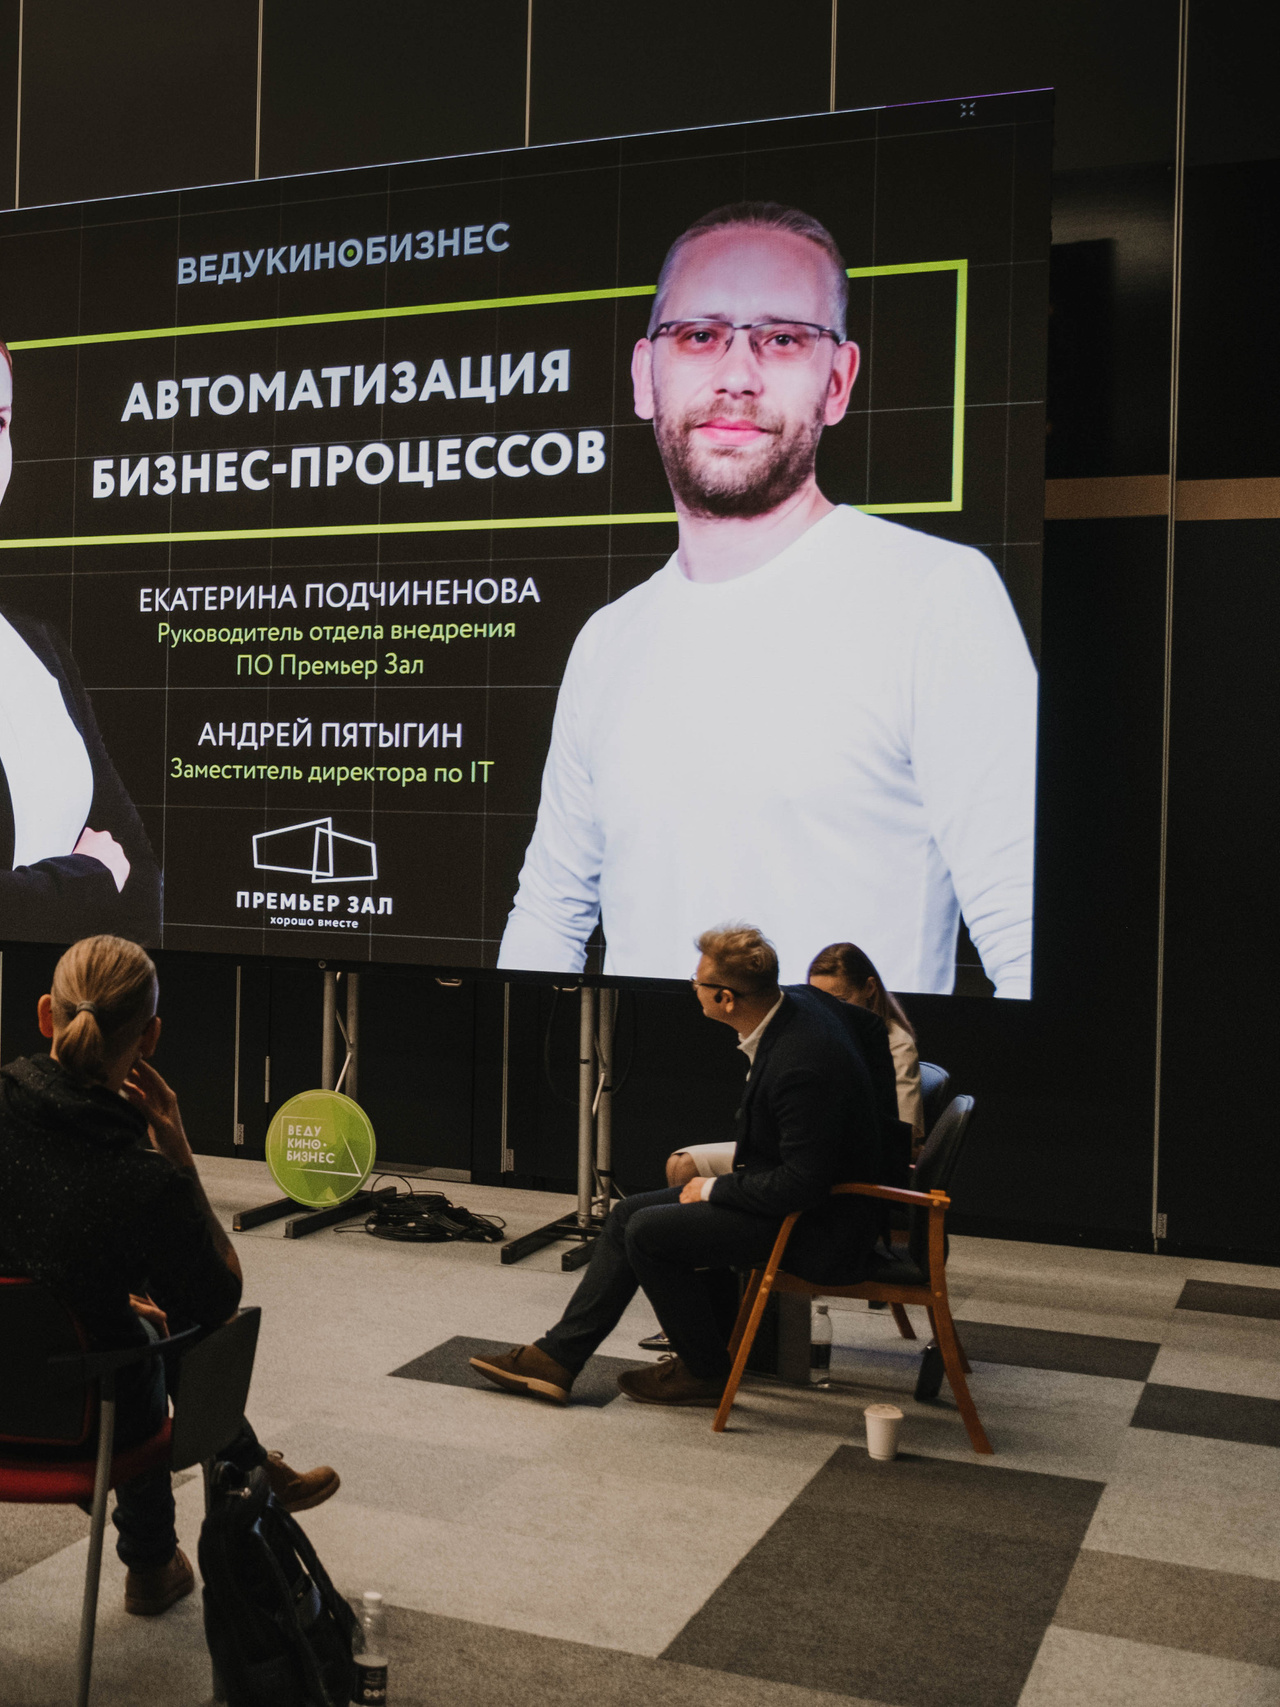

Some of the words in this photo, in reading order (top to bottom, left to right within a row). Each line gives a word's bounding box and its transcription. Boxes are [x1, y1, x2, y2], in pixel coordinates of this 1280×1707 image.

[177, 222, 511, 286] ВЕДУКИНОБИЗНЕС
[120, 348, 572, 423] АВТОМАТИЗАЦИЯ
[92, 429, 607, 499] БИЗНЕС-ПРОЦЕССОВ
[139, 584, 298, 612] ЕКАТЕРИНА
[305, 576, 541, 611] ПОДЧИНЕНОВА
[157, 622, 304, 648] Руководитель
[309, 624, 384, 644] отдела
[390, 621, 516, 645] внедрения
[236, 653, 274, 676] ПО
[280, 652, 378, 681] Премьер
[384, 652, 424, 675] Зал
[197, 717, 312, 751] АНДРЕЙ
[321, 722, 463, 749] ПЯТЫГИН
[170, 757, 303, 781] Заместитель
[307, 763, 427, 788] директора
[434, 767, 463, 784] по
[236, 890, 341, 913] ПРЕМЬЕР
[346, 895, 393, 916] ЗАЛ
[269, 916, 315, 928] хорошо
[317, 918, 360, 930] вместе
[287, 1125, 322, 1137] ВЕДУ
[286, 1150, 335, 1164] БИЗНЕС
